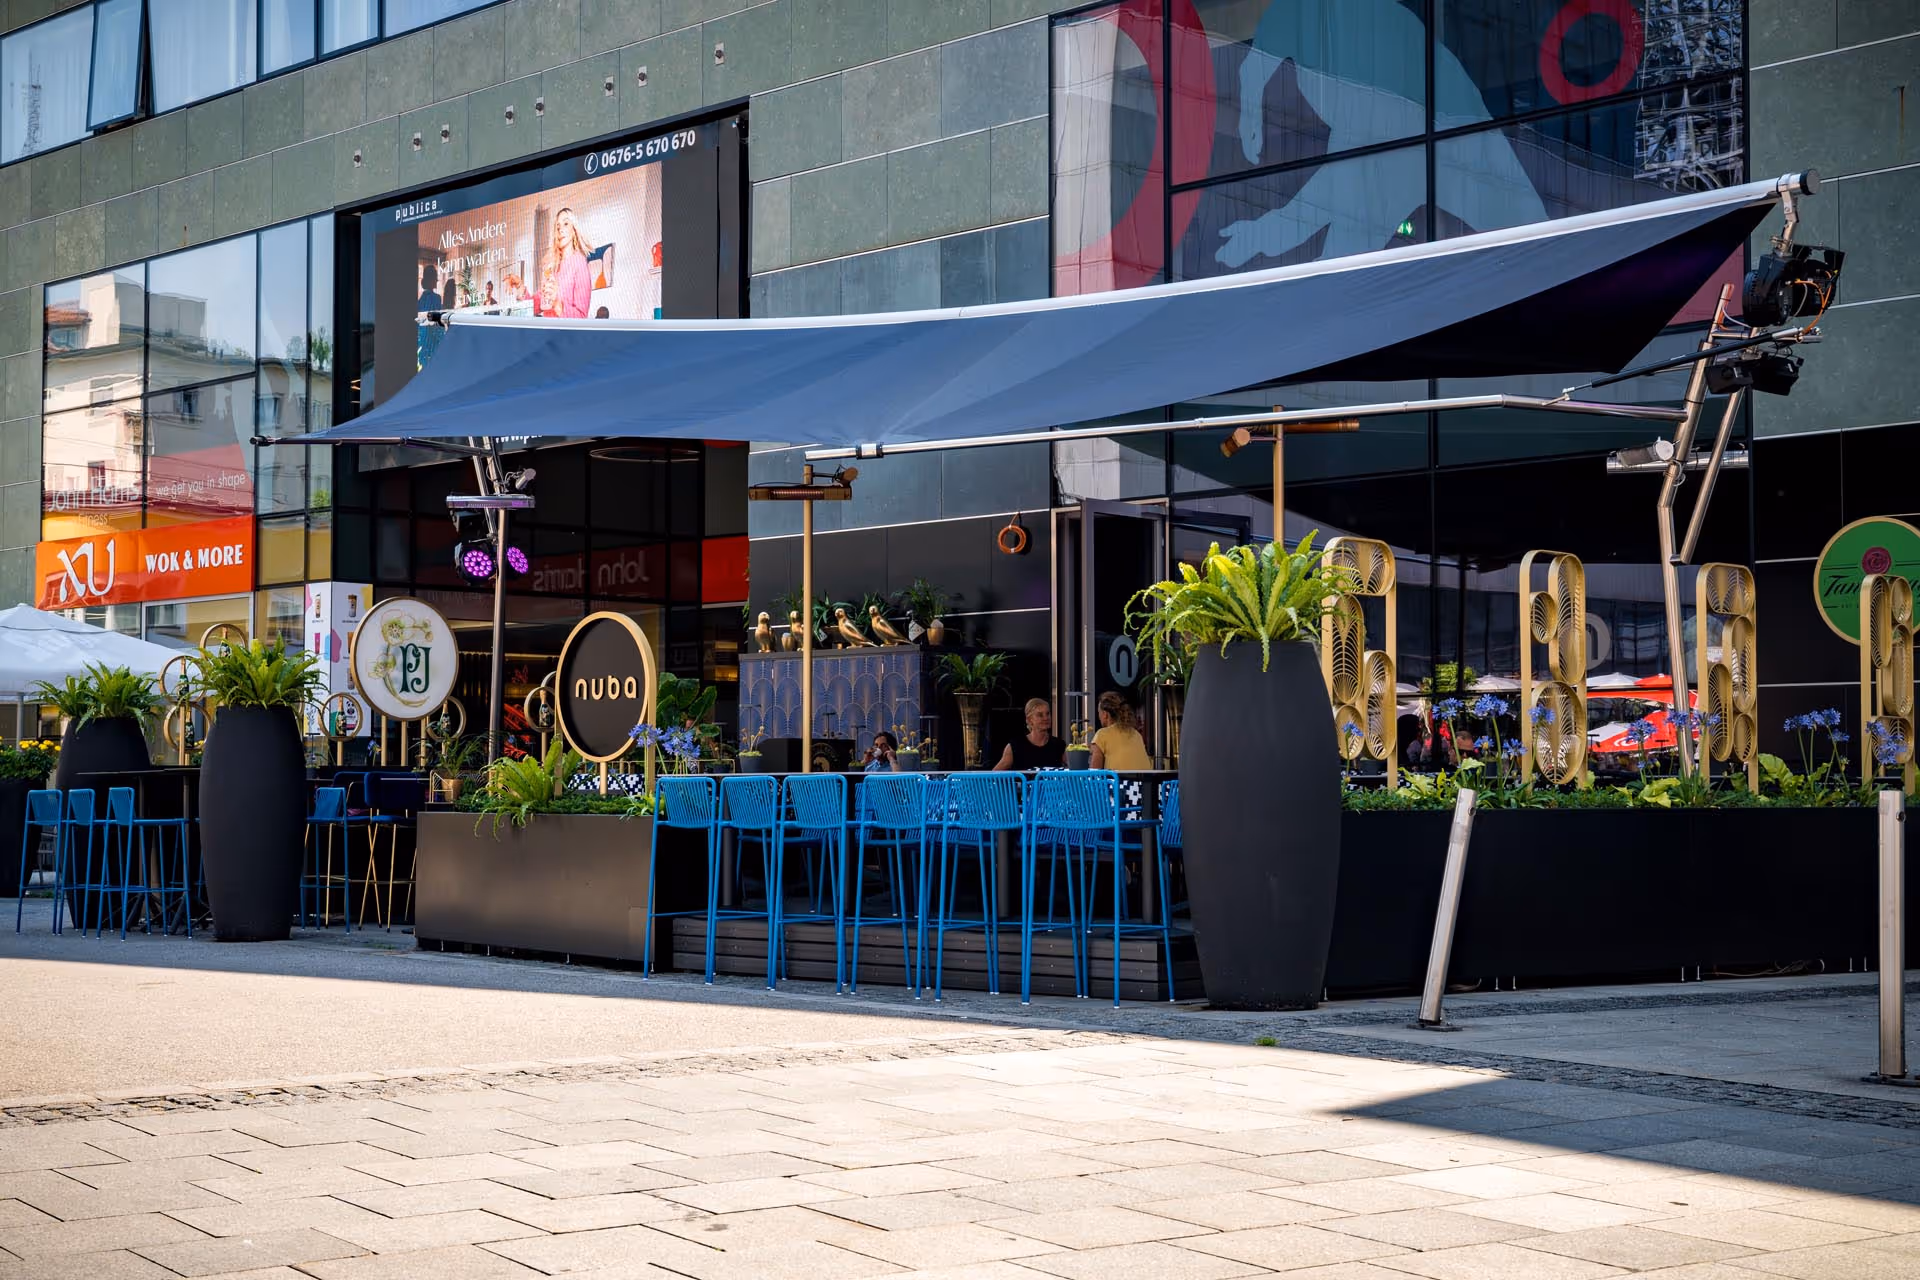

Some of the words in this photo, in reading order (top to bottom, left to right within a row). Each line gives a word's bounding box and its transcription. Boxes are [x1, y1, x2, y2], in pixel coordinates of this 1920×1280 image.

[601, 143, 643, 168] 0676-5
[646, 136, 669, 157] 670
[671, 130, 696, 150] 670
[438, 230, 465, 250] Alles
[466, 221, 507, 243] Andere
[437, 257, 464, 275] kann
[466, 247, 508, 268] warten.
[48, 472, 86, 512] John
[156, 486, 169, 497] we
[171, 480, 186, 499] get
[188, 480, 204, 497] you
[207, 475, 215, 488] in
[218, 470, 246, 491] shape
[57, 538, 115, 603] XU
[145, 552, 180, 574] WOK
[182, 550, 194, 570] &
[197, 544, 244, 569] MORE
[575, 675, 637, 700] nuba
